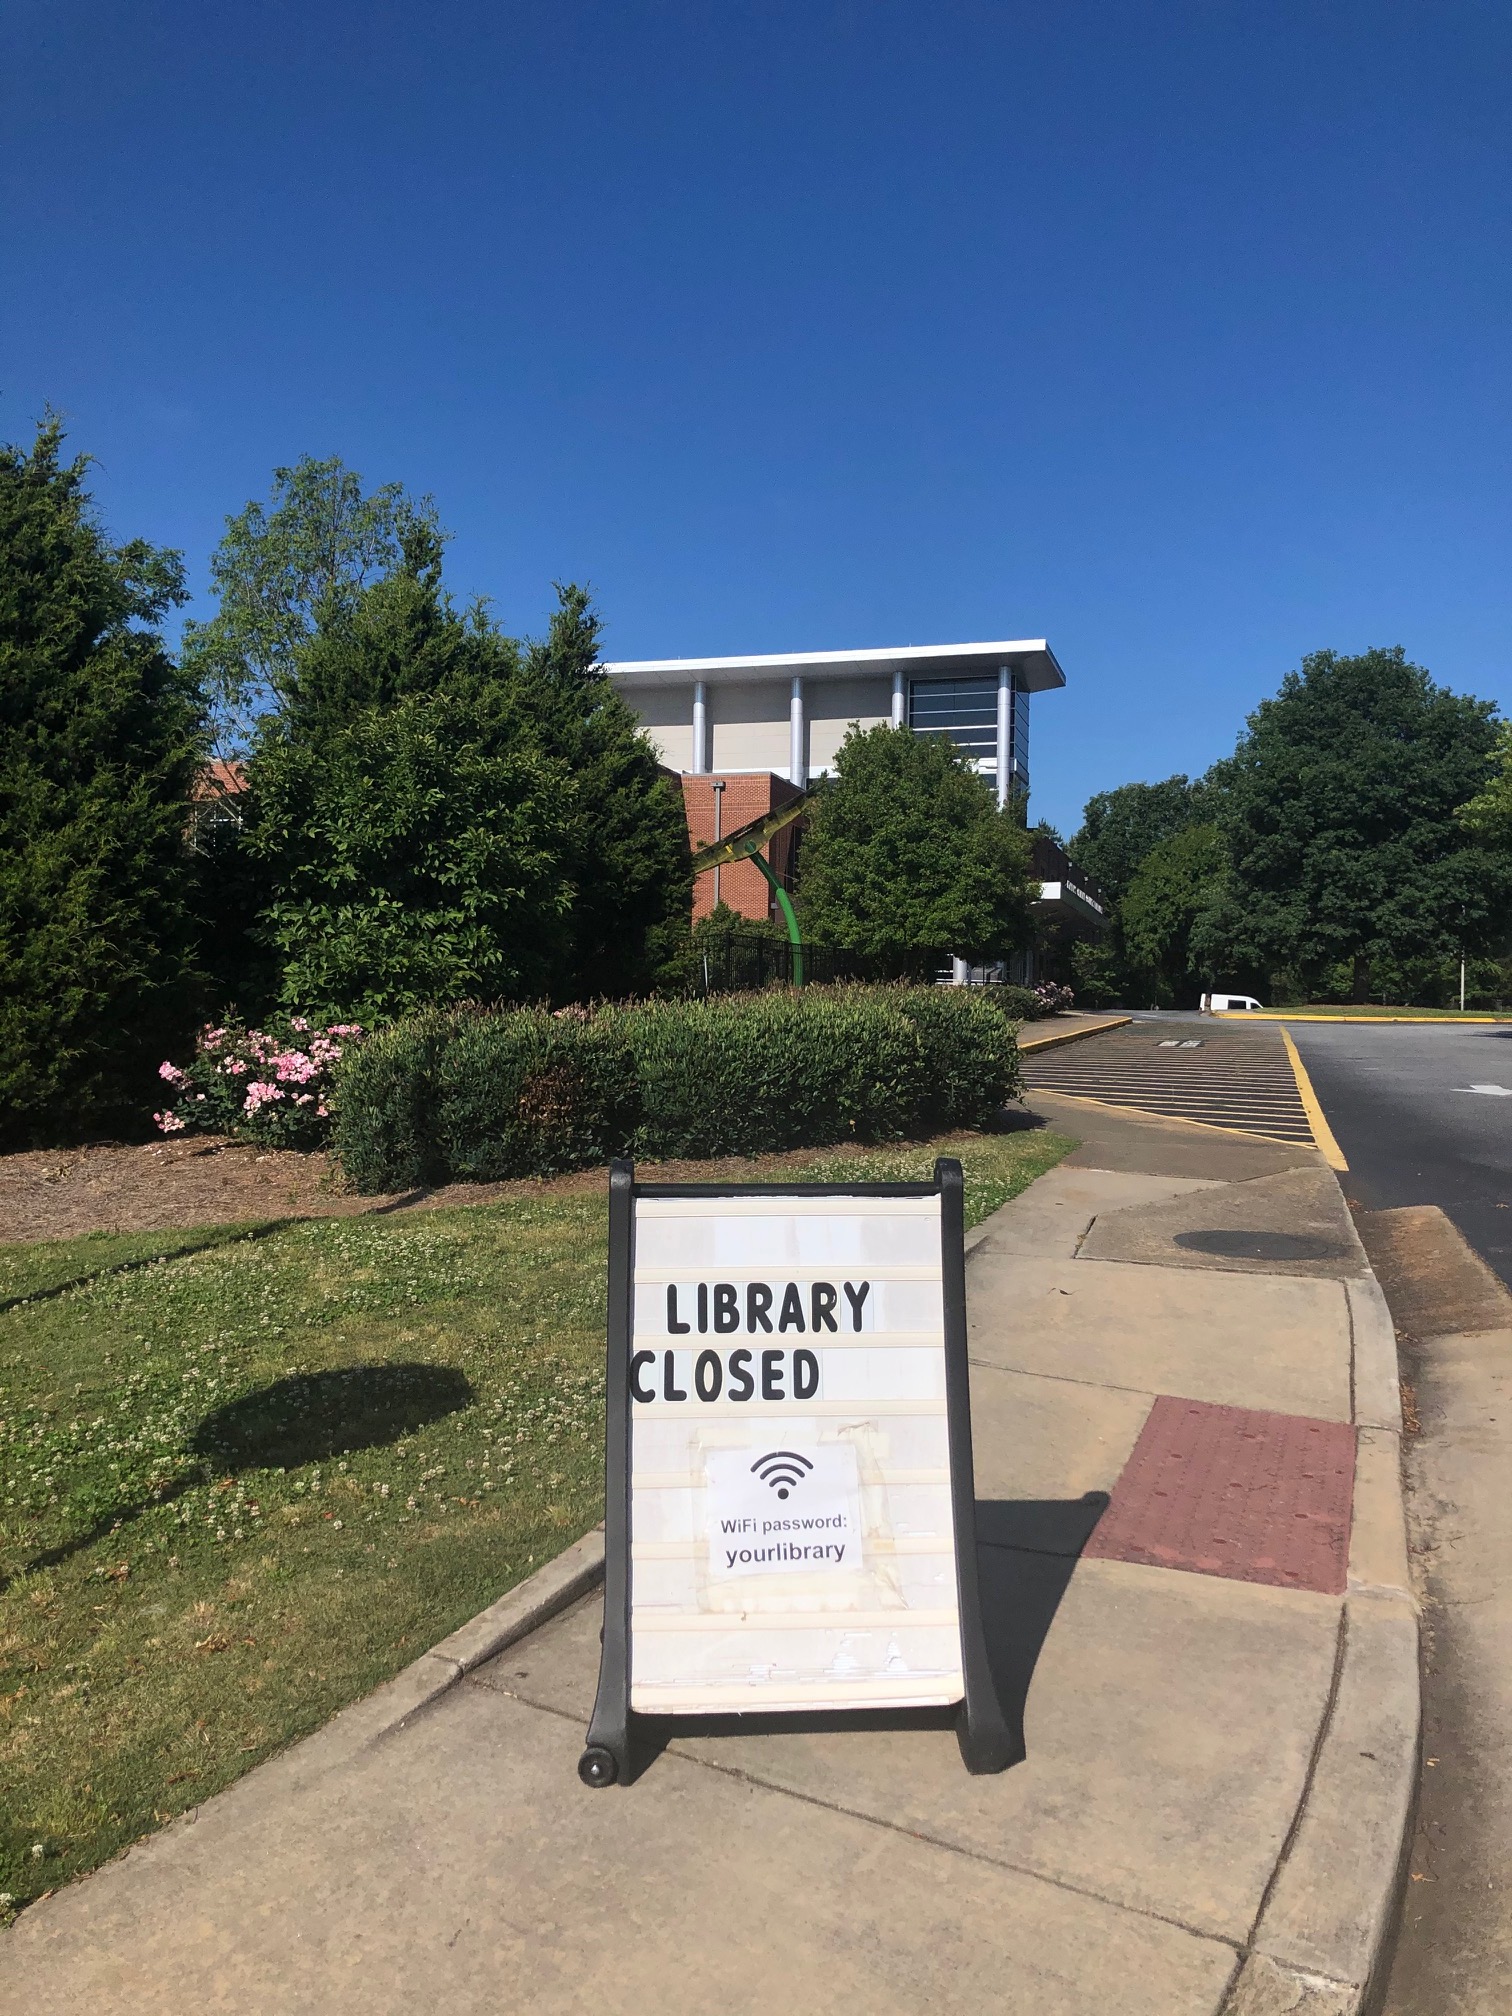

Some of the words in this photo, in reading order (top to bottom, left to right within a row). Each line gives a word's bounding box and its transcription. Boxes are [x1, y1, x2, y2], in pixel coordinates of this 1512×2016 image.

[667, 1281, 870, 1335] LIBRARY
[631, 1349, 819, 1403] CLOSED
[720, 1518, 757, 1534] WiFi
[762, 1514, 847, 1535] password:
[726, 1542, 846, 1568] yourlibrary
